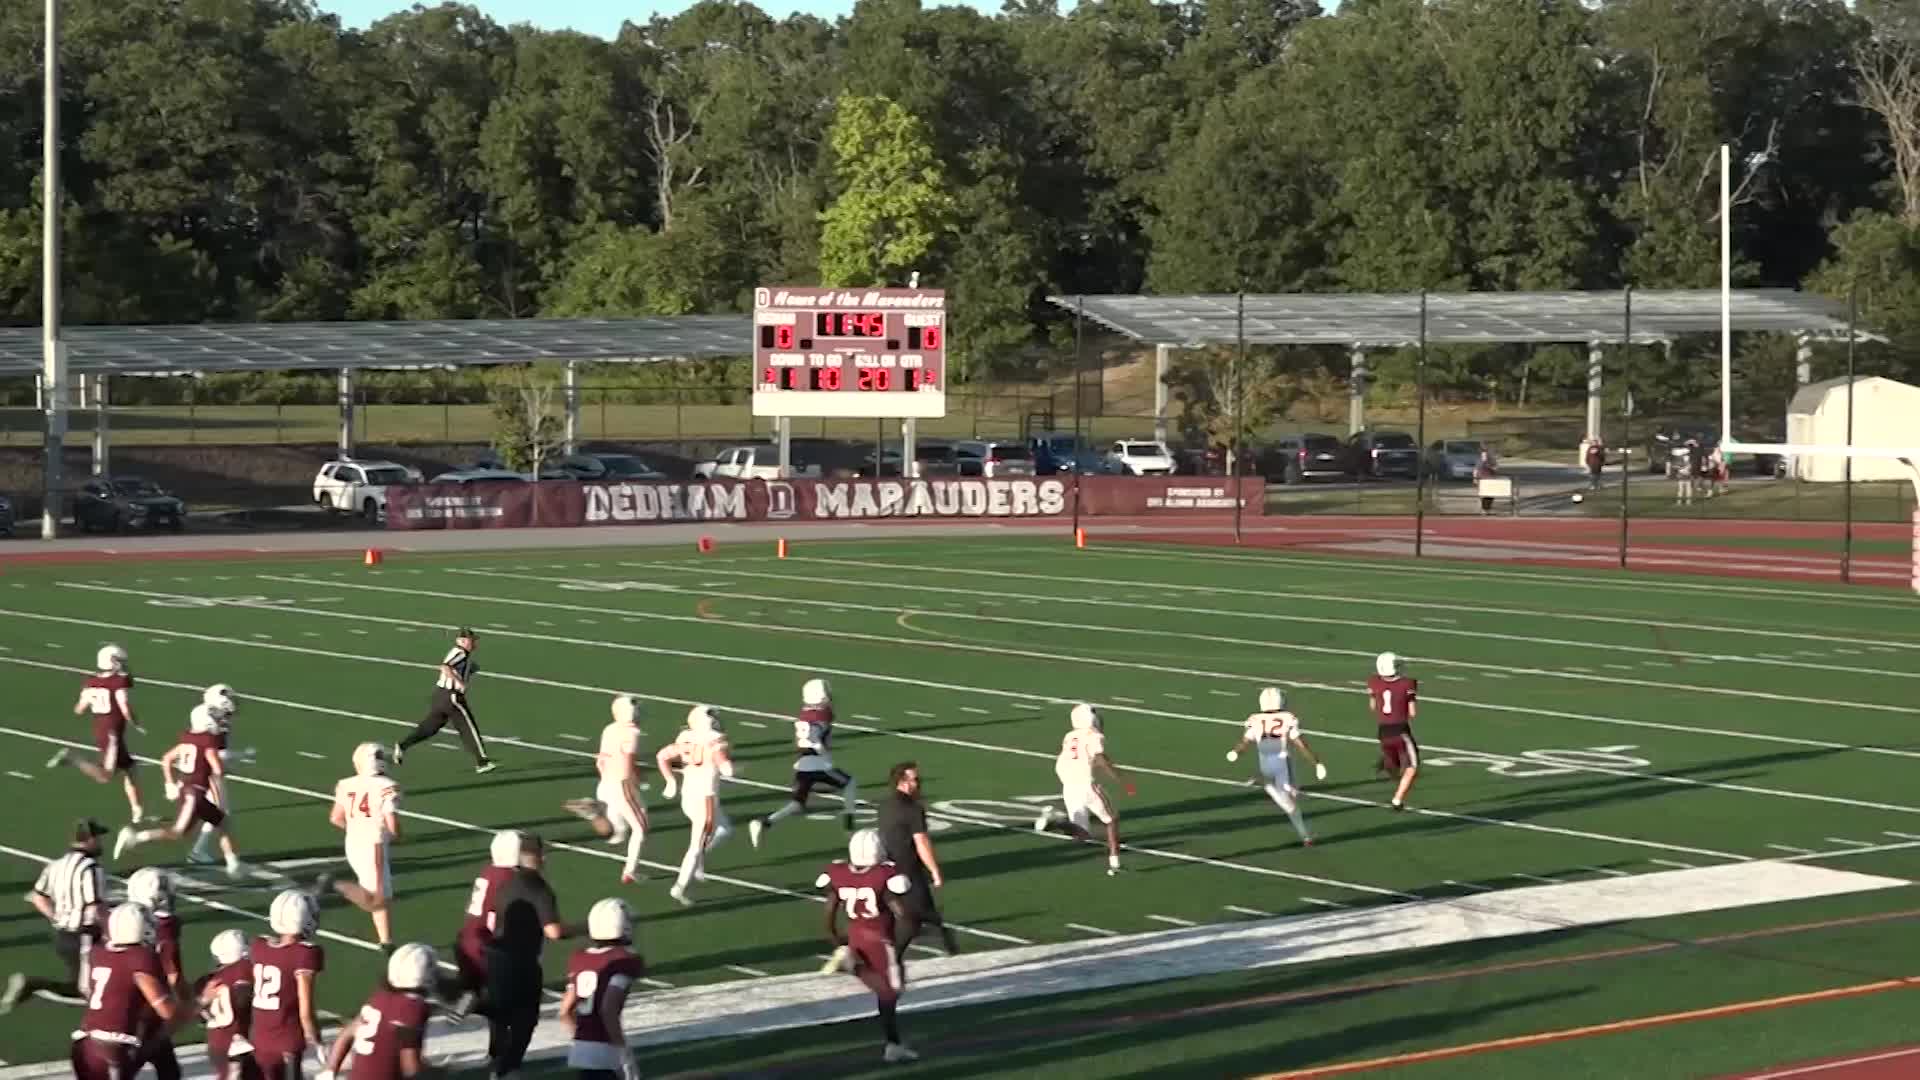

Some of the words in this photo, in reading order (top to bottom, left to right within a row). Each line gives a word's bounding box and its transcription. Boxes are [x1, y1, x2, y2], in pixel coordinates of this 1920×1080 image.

[774, 291, 816, 306] Home
[818, 291, 834, 306] of
[837, 291, 860, 306] the
[861, 291, 944, 308] Marauders
[904, 313, 940, 326] GUEST
[777, 325, 793, 350] 0
[923, 326, 941, 350] 0
[858, 367, 890, 390] 20
[582, 483, 746, 520] DEDHAM
[815, 481, 1065, 517] MARAUDERS
[1382, 689, 1392, 714] 1
[1261, 719, 1284, 738] 12
[347, 791, 372, 818] 74
[838, 887, 880, 919] 73
[90, 966, 112, 1010] 7
[252, 963, 281, 1010] 12
[352, 1005, 382, 1056] 2
